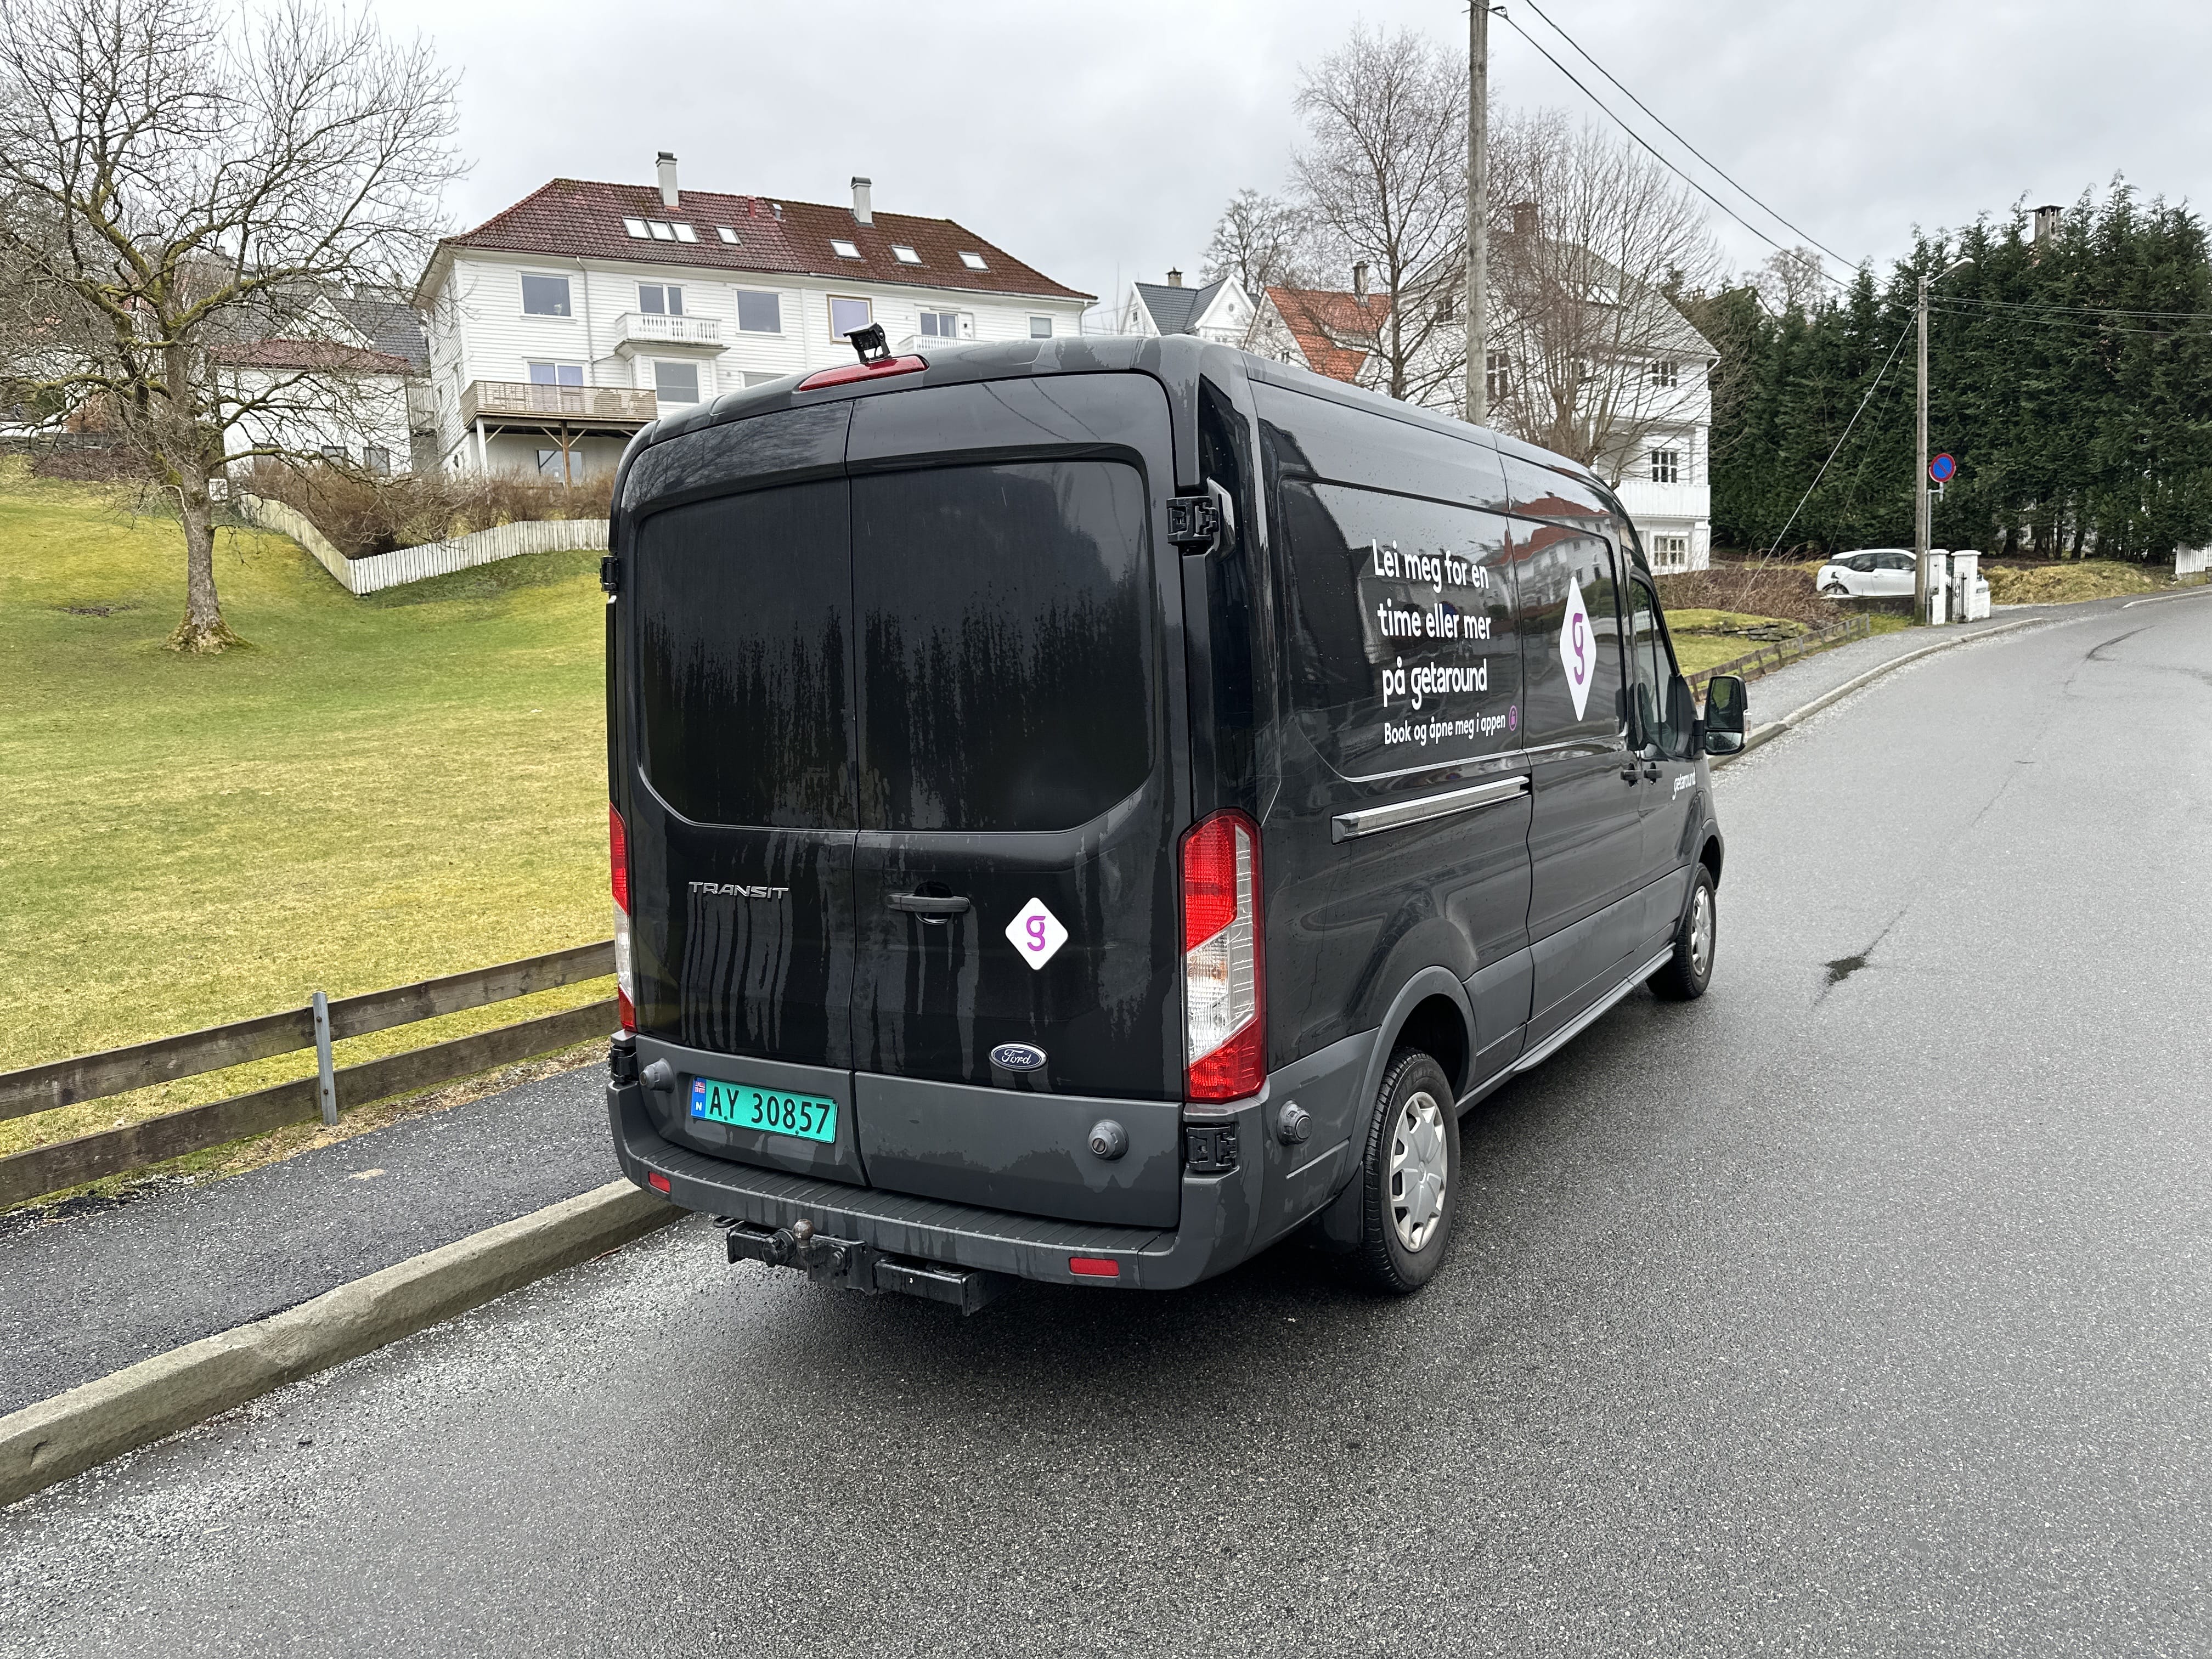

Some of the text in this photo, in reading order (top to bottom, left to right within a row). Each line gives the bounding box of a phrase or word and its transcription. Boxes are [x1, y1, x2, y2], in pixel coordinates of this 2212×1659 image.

[1372, 538, 1489, 594] Lei meg for en
[1377, 598, 1491, 640] time eller mer
[1572, 612, 1585, 685] g
[1382, 656, 1487, 710] på getaround
[1384, 712, 1506, 746] Book og åpne meg i appen
[1672, 766, 1696, 801] getaround
[689, 881, 789, 899] TRANSIT
[1026, 915, 1046, 951] g
[1001, 1048, 1032, 1064] Ford
[695, 1101, 702, 1111] N
[709, 1086, 831, 1135] AY 30857
